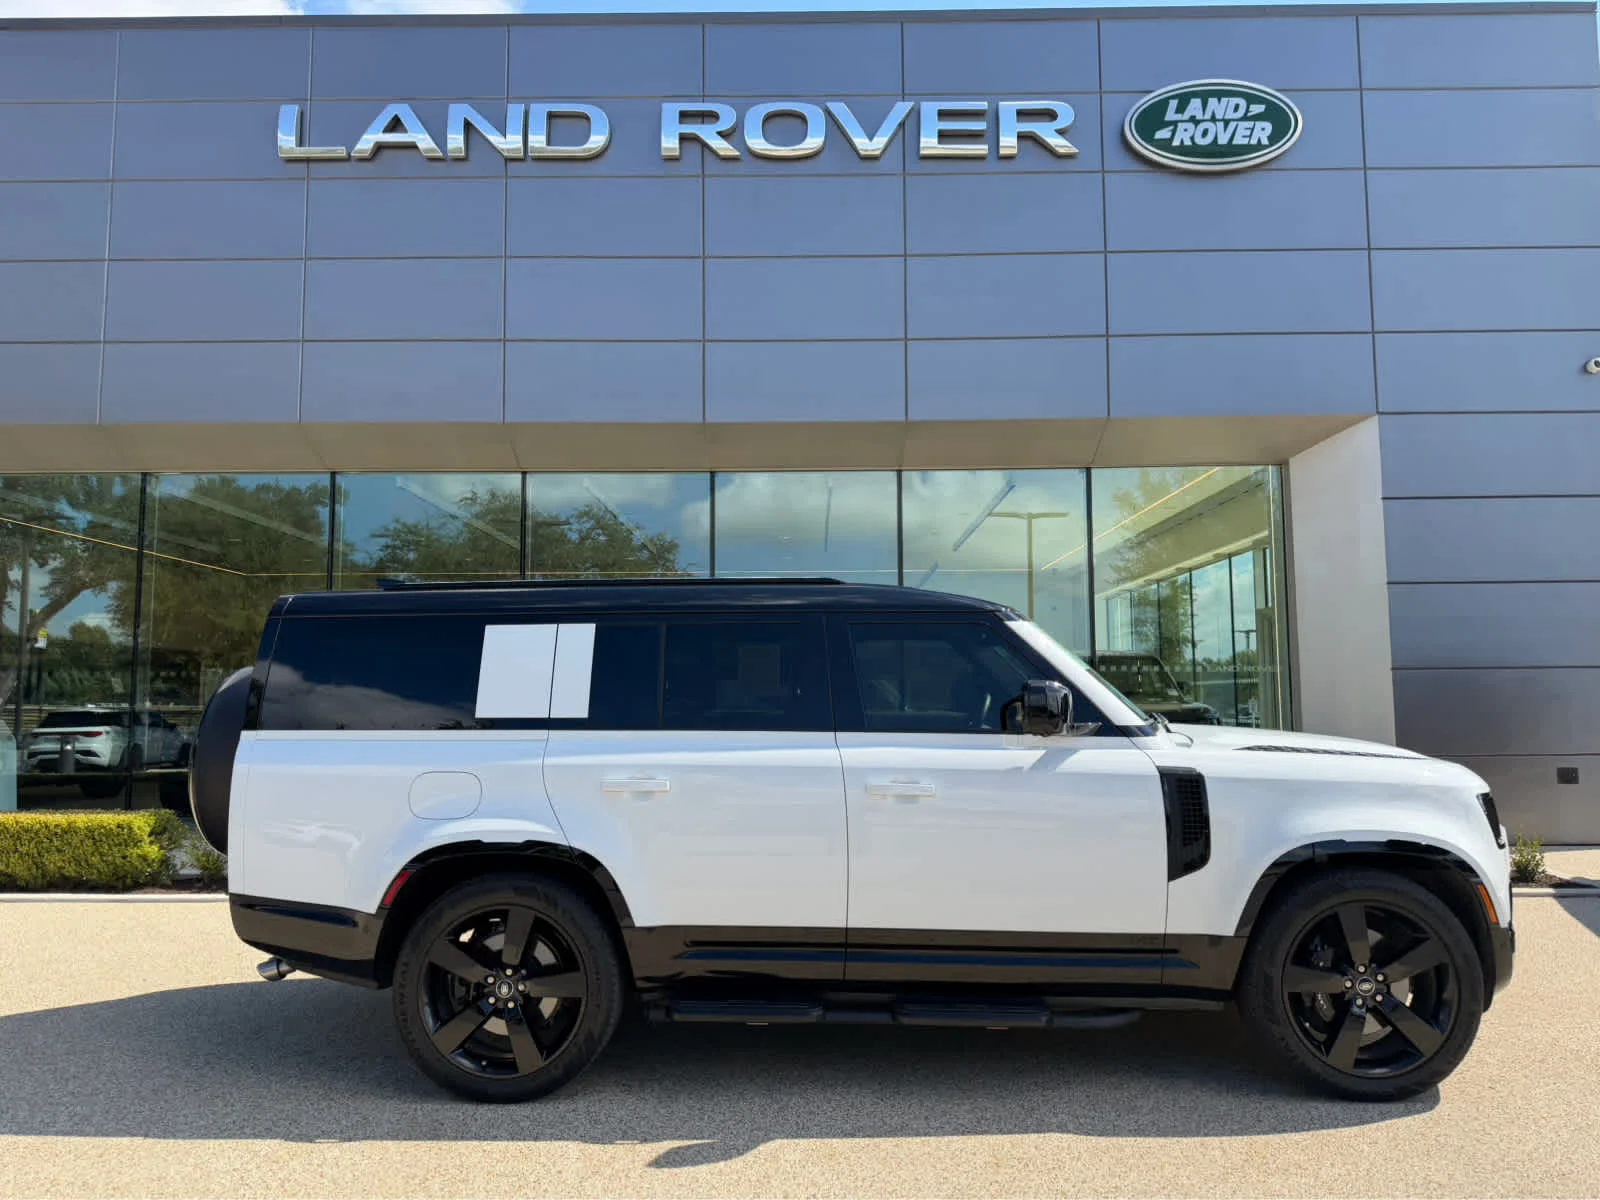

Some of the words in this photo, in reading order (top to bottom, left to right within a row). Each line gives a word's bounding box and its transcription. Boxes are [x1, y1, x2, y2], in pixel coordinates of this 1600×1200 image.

[1164, 97, 1247, 121] LAND
[278, 103, 611, 160] LAND
[661, 100, 1079, 160] ROVER
[1171, 121, 1273, 146] ROVER
